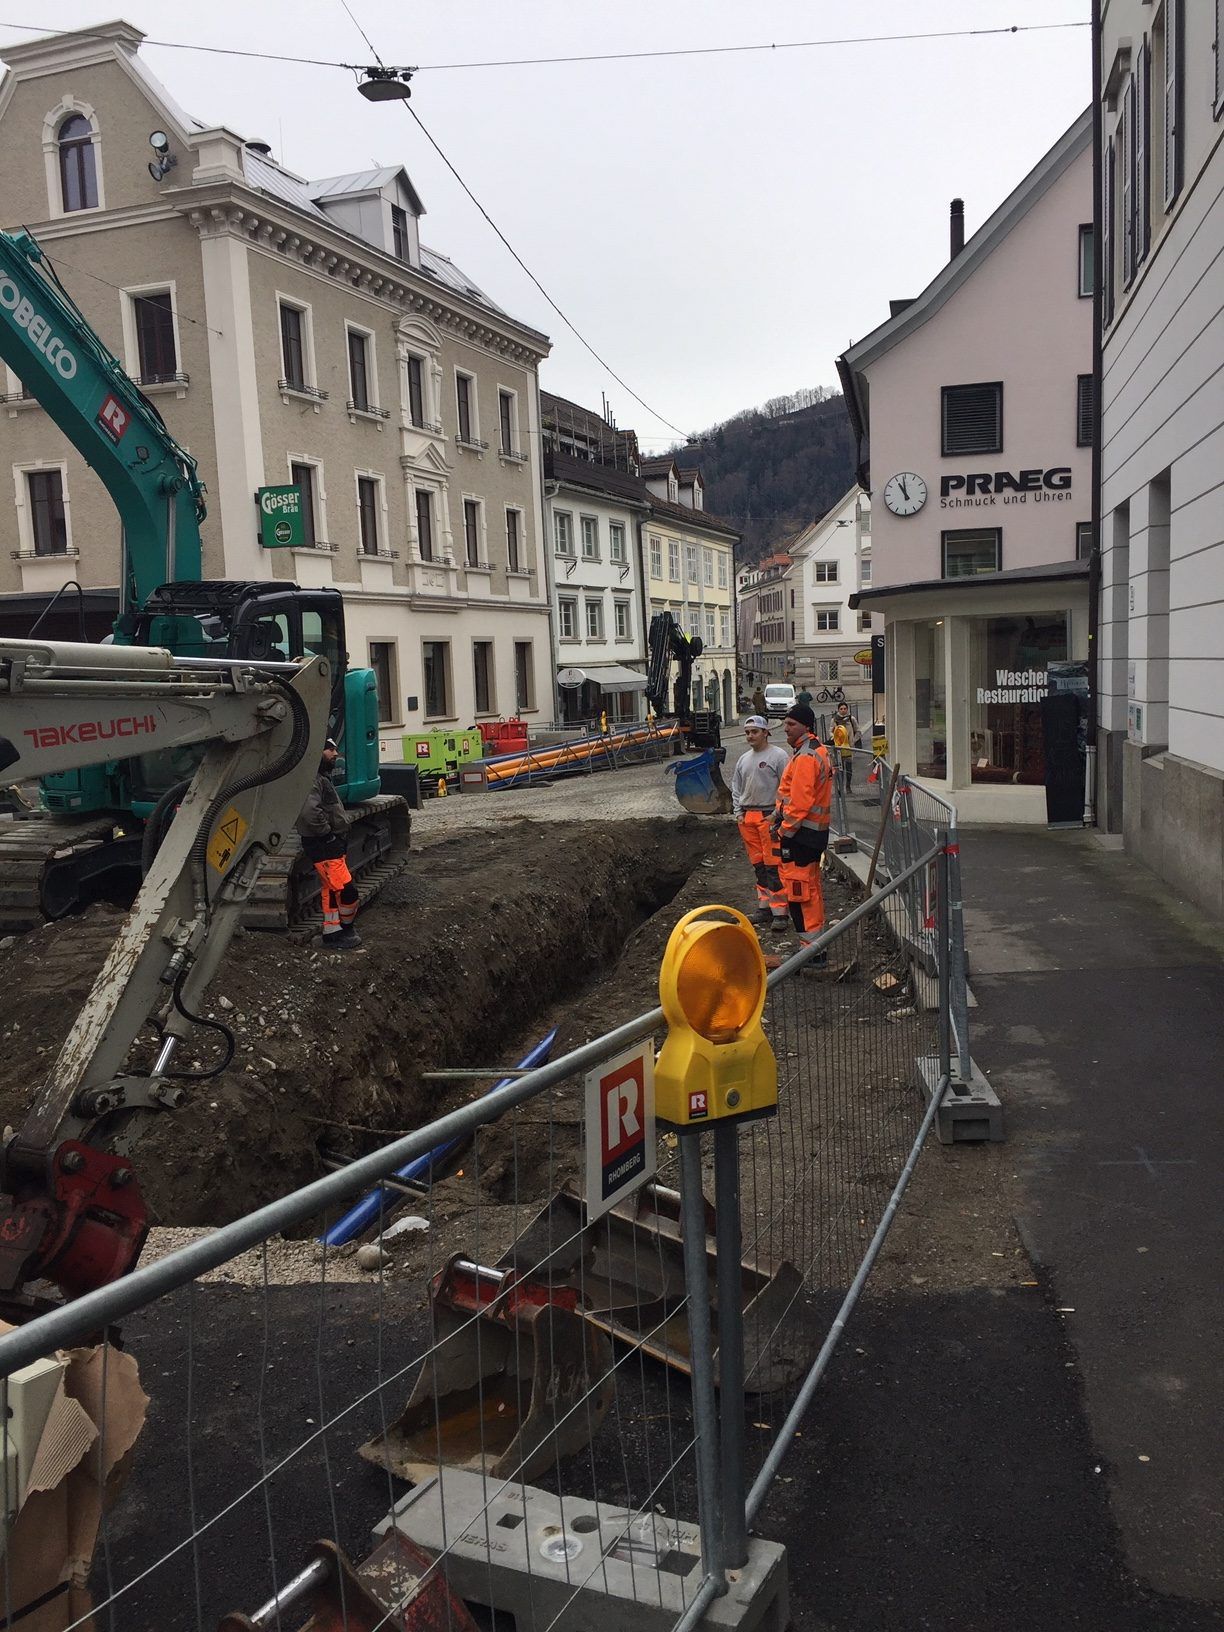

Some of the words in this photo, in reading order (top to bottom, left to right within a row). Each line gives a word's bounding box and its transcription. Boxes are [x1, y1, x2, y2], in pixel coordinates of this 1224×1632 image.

[0, 269, 77, 380] OBELCO
[940, 467, 1072, 497] PRAEG
[261, 491, 300, 514] Gösser
[940, 496, 997, 508] Schmuck
[1003, 492, 1027, 504] und
[1034, 491, 1072, 503] Uhren
[976, 687, 1049, 704] Restauratio
[691, 1093, 706, 1109] R
[607, 1077, 641, 1152] R
[608, 1152, 641, 1185] RHOMBERG
